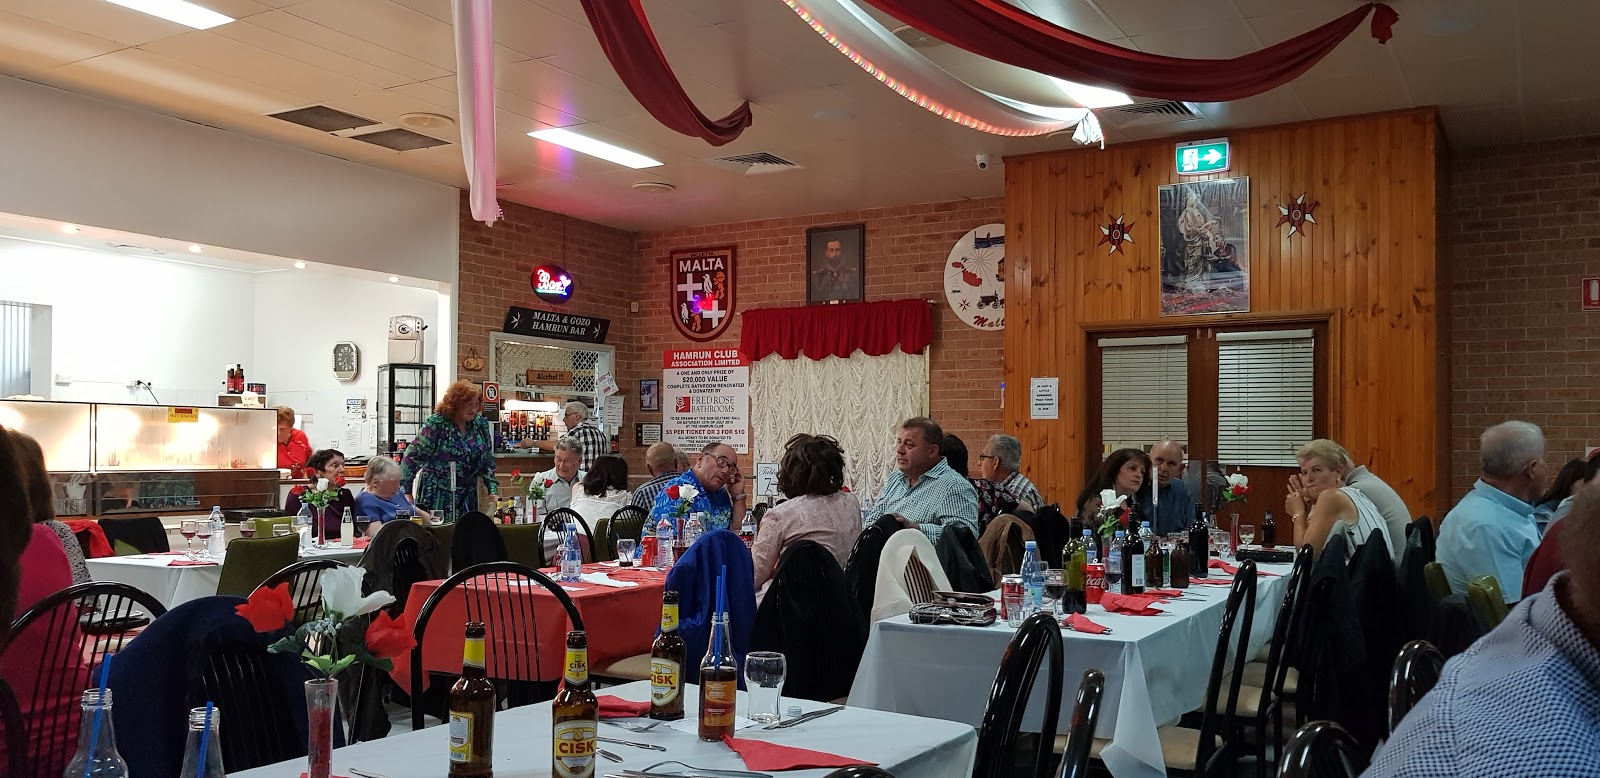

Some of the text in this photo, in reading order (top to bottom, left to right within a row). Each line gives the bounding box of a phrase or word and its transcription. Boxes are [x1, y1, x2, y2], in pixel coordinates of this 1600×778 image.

[680, 258, 724, 272] MALTA
[537, 268, 564, 290] Bar
[532, 312, 590, 326] MALTA & GOZO
[532, 322, 586, 336] HAMRUN BAR
[674, 350, 738, 360] HAMRUN CLUB
[691, 396, 734, 404] FRED ROSE
[558, 740, 594, 754] CISK
